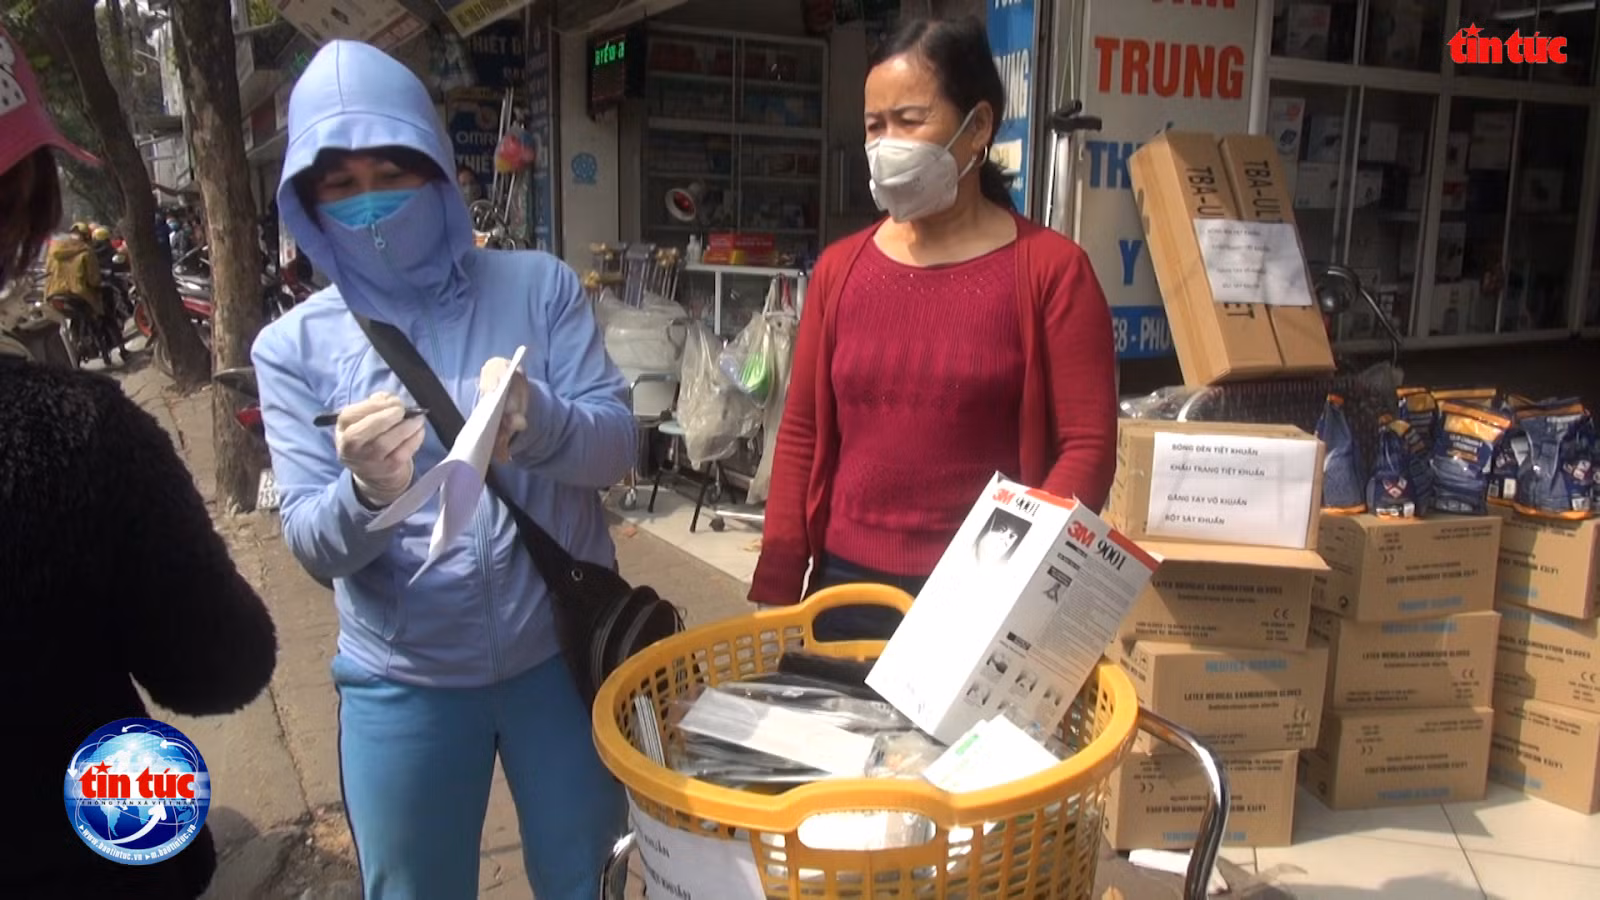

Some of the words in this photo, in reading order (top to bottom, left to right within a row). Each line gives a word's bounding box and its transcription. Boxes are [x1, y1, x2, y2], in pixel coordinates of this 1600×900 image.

[1094, 36, 1245, 100] TRUNG
[1118, 239, 1143, 286] Y
[1193, 465, 1219, 474] TRANG
[992, 488, 1016, 504] 3M
[1016, 496, 1040, 518] 9001
[1067, 520, 1096, 548] 3M
[1097, 539, 1127, 571] 9001
